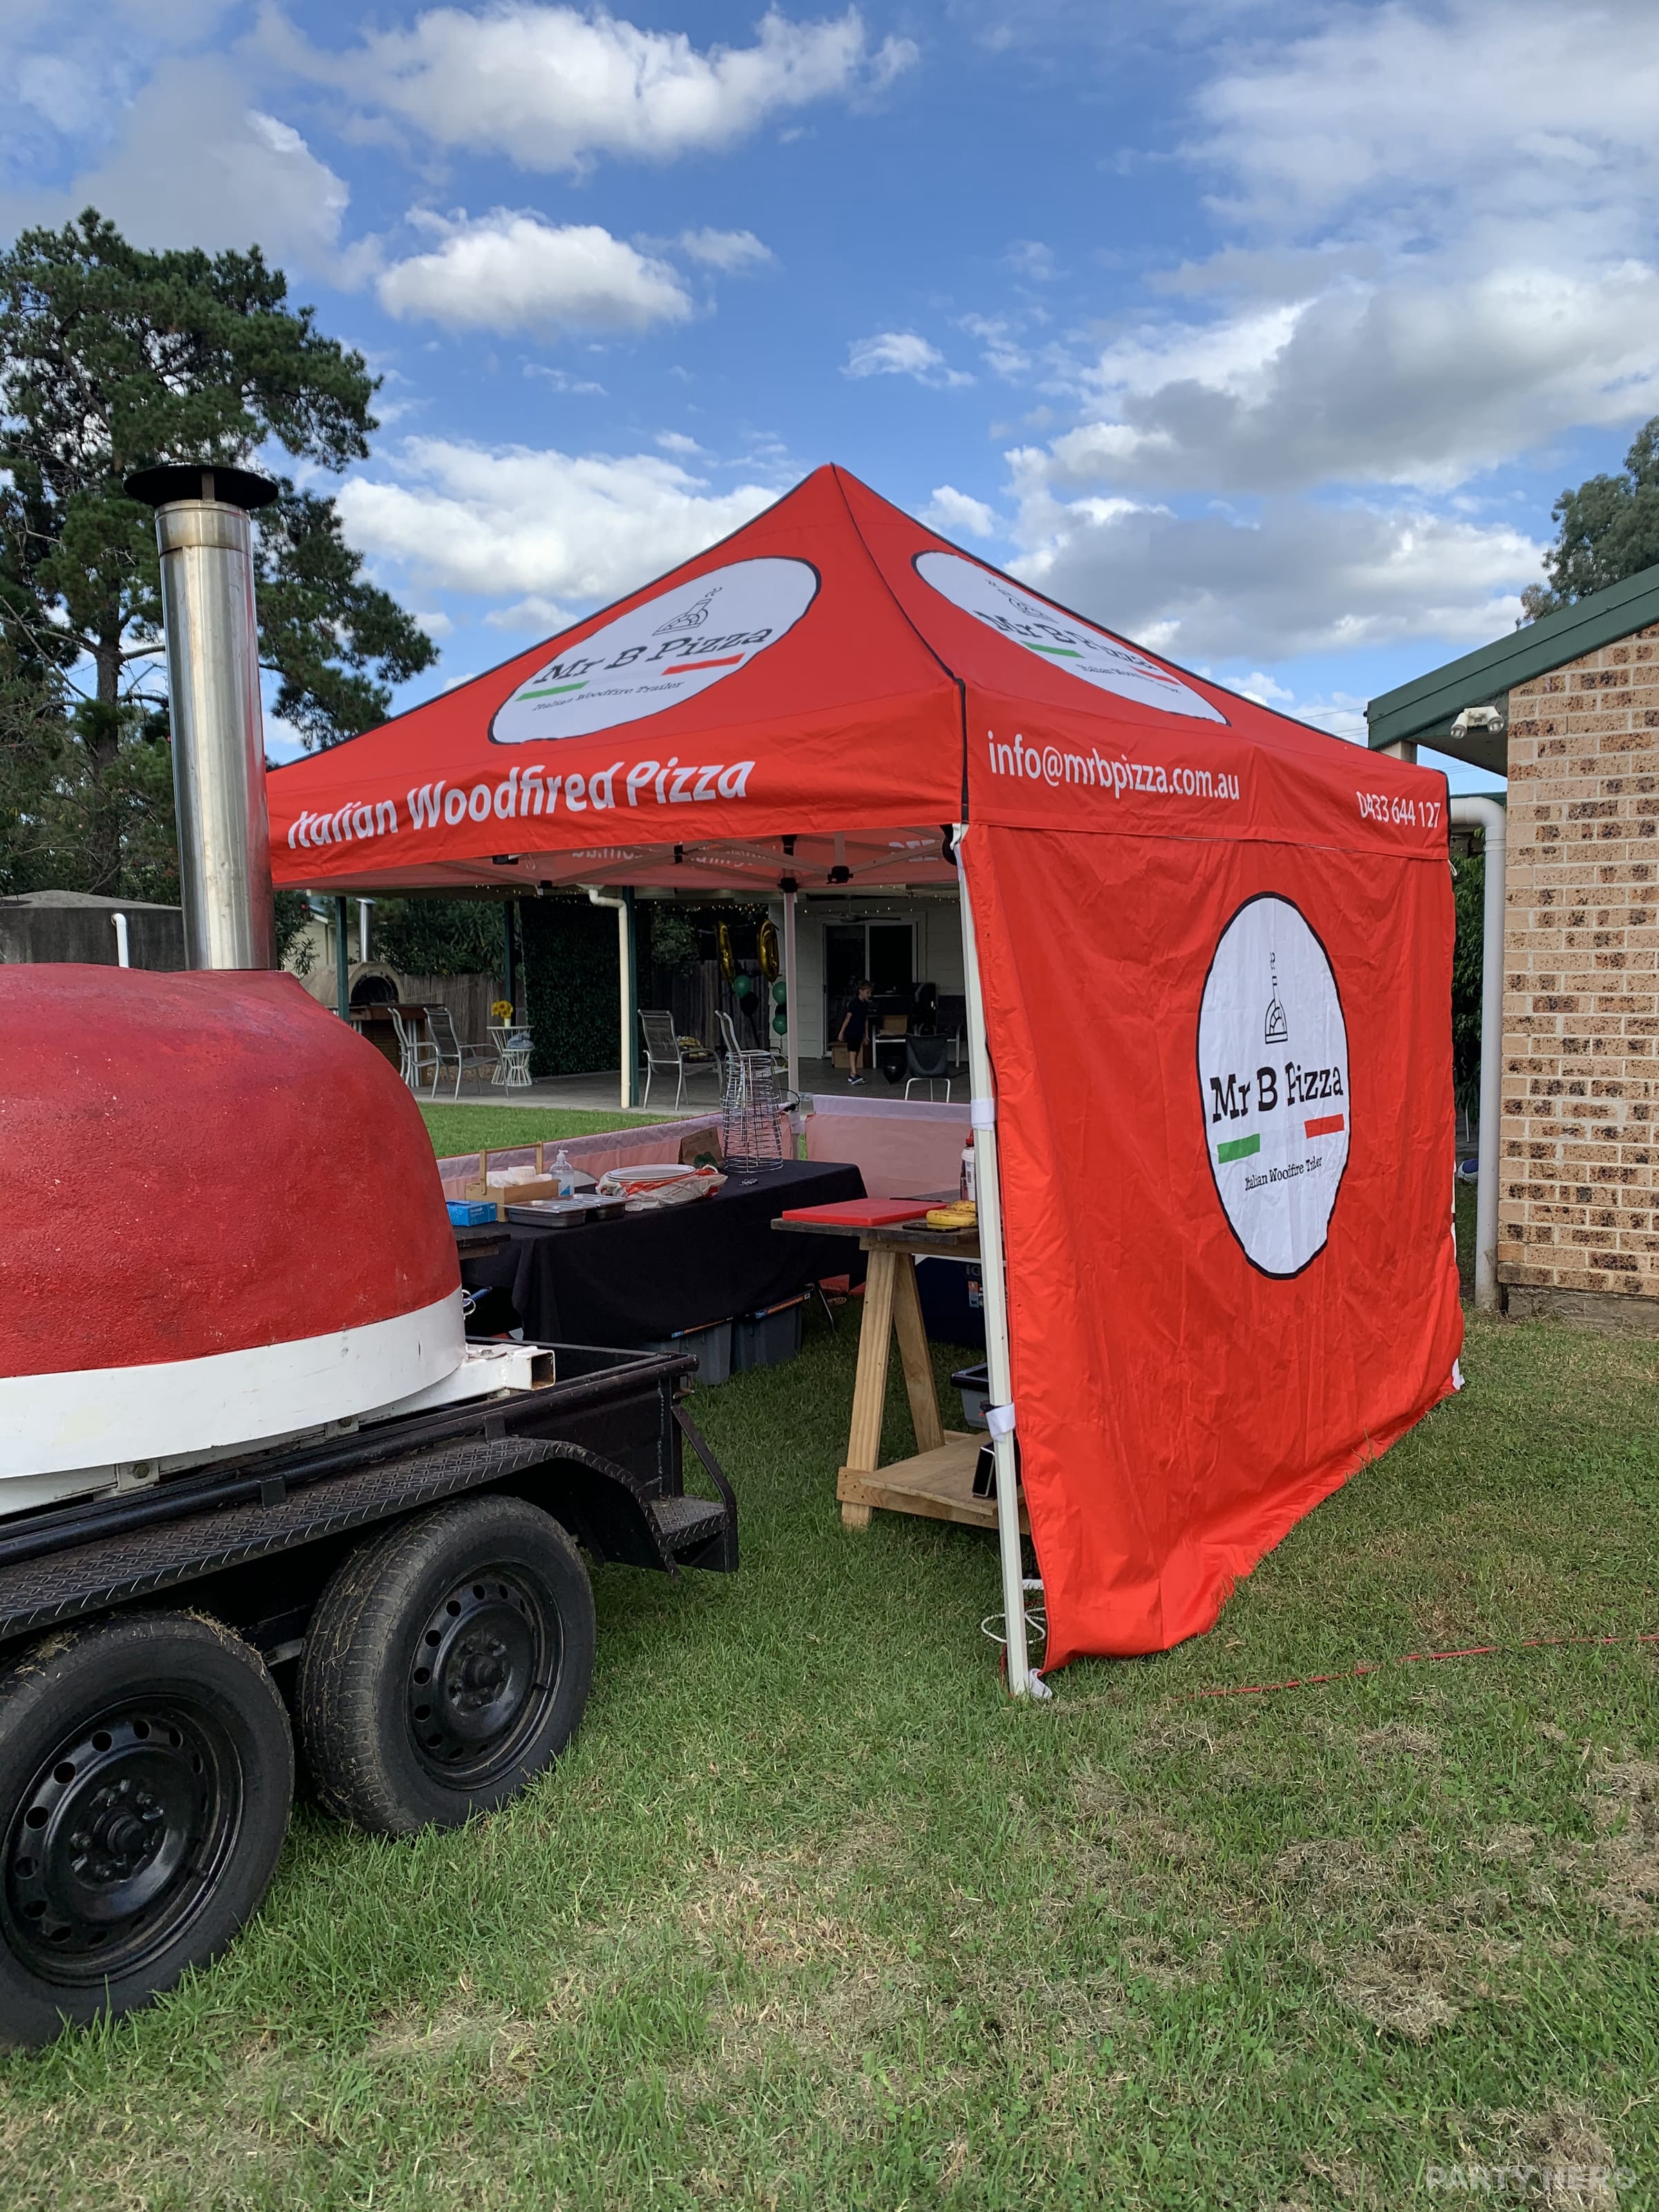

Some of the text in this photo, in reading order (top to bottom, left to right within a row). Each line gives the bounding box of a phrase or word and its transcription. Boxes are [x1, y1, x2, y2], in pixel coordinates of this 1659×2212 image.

[532, 628, 773, 685] Mr B Pizza
[1032, 623, 1077, 644] B
[635, 682, 684, 693] Trailer
[987, 731, 1239, 800] info@mrbpizza.com.au
[288, 756, 756, 849] Italian Woodfired Pizza
[1356, 791, 1441, 828] 0433 644 127
[1210, 1062, 1343, 1123] Mr B Pizza
